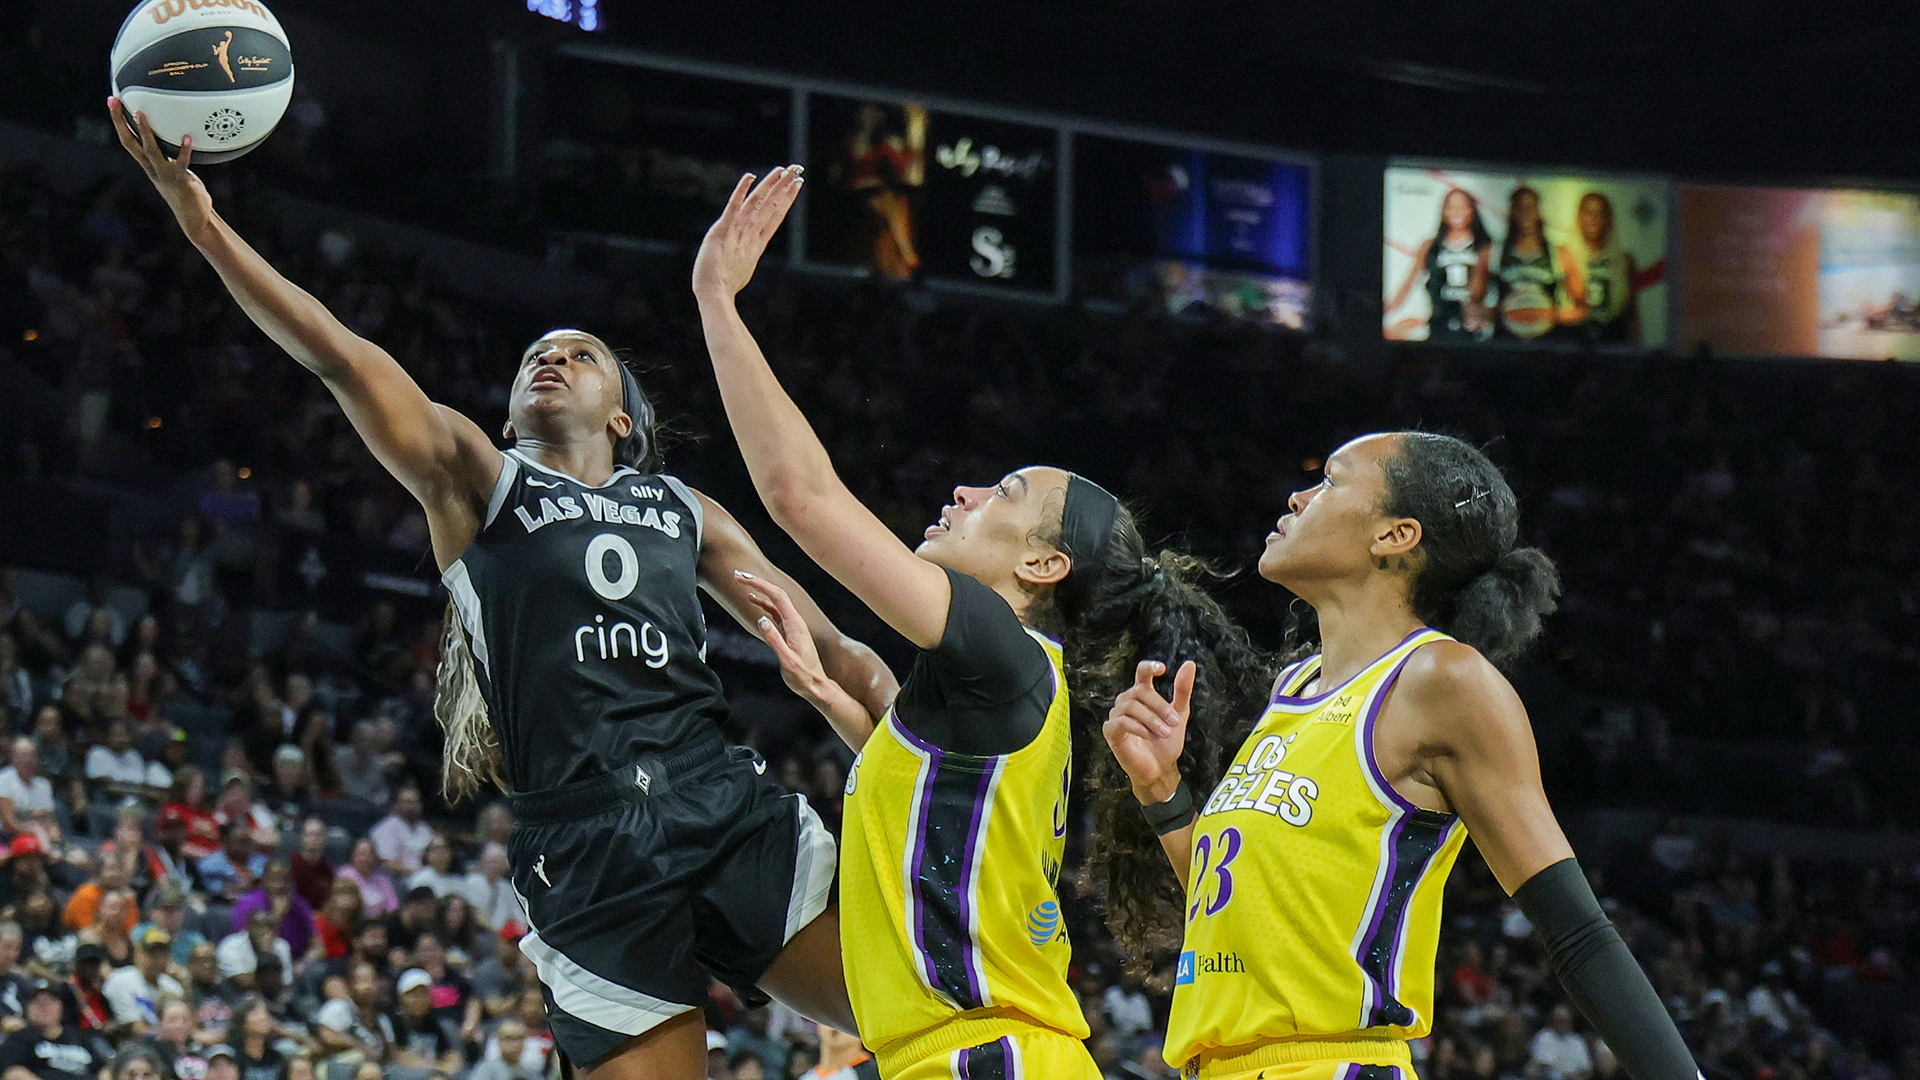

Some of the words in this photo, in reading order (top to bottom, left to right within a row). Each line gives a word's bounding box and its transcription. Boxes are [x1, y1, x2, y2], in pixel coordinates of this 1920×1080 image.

[513, 496, 584, 534] LAS
[581, 492, 682, 539] VEGAS
[630, 485, 664, 502] ally
[585, 532, 640, 601] 0
[574, 614, 670, 669] ring
[1317, 710, 1352, 724] Albert
[1204, 769, 1319, 828] GELES
[1188, 825, 1243, 925] 23
[1197, 952, 1246, 976] Halth
